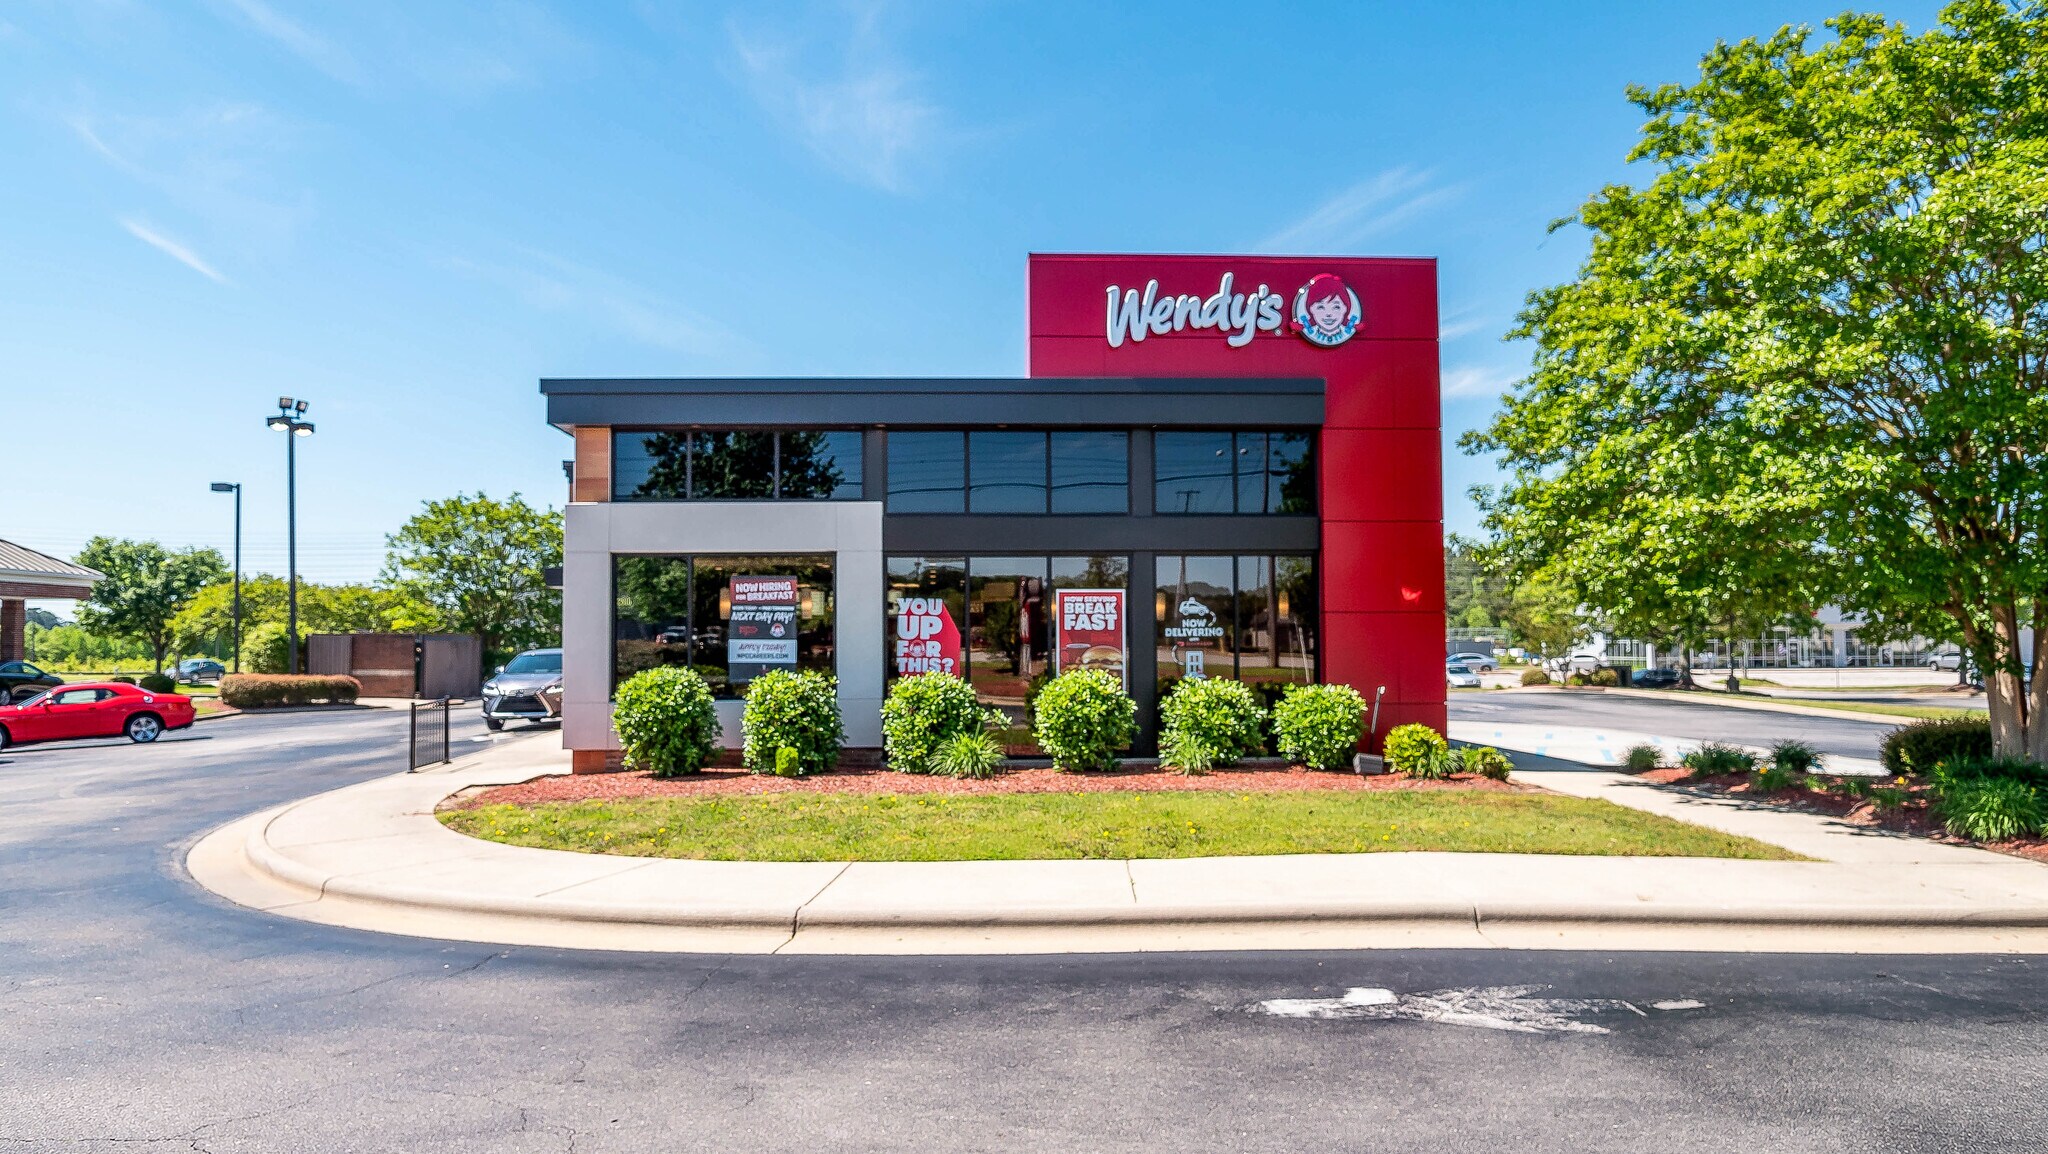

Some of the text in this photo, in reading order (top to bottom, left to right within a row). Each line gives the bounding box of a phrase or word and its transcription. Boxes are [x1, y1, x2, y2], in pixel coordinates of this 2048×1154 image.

[1105, 271, 1284, 348] Wendy's
[736, 582, 791, 593] NOW HIRING
[747, 591, 794, 601] BREAKFAST
[897, 598, 943, 615] YOU
[1064, 602, 1117, 614] BREAK
[731, 611, 794, 624] NEXT DAY PAY!
[1064, 613, 1118, 630] FAST
[1182, 618, 1207, 628] NOW
[897, 615, 943, 640] UP
[1165, 627, 1224, 637] DELIVERING
[896, 657, 954, 673] THIS?
